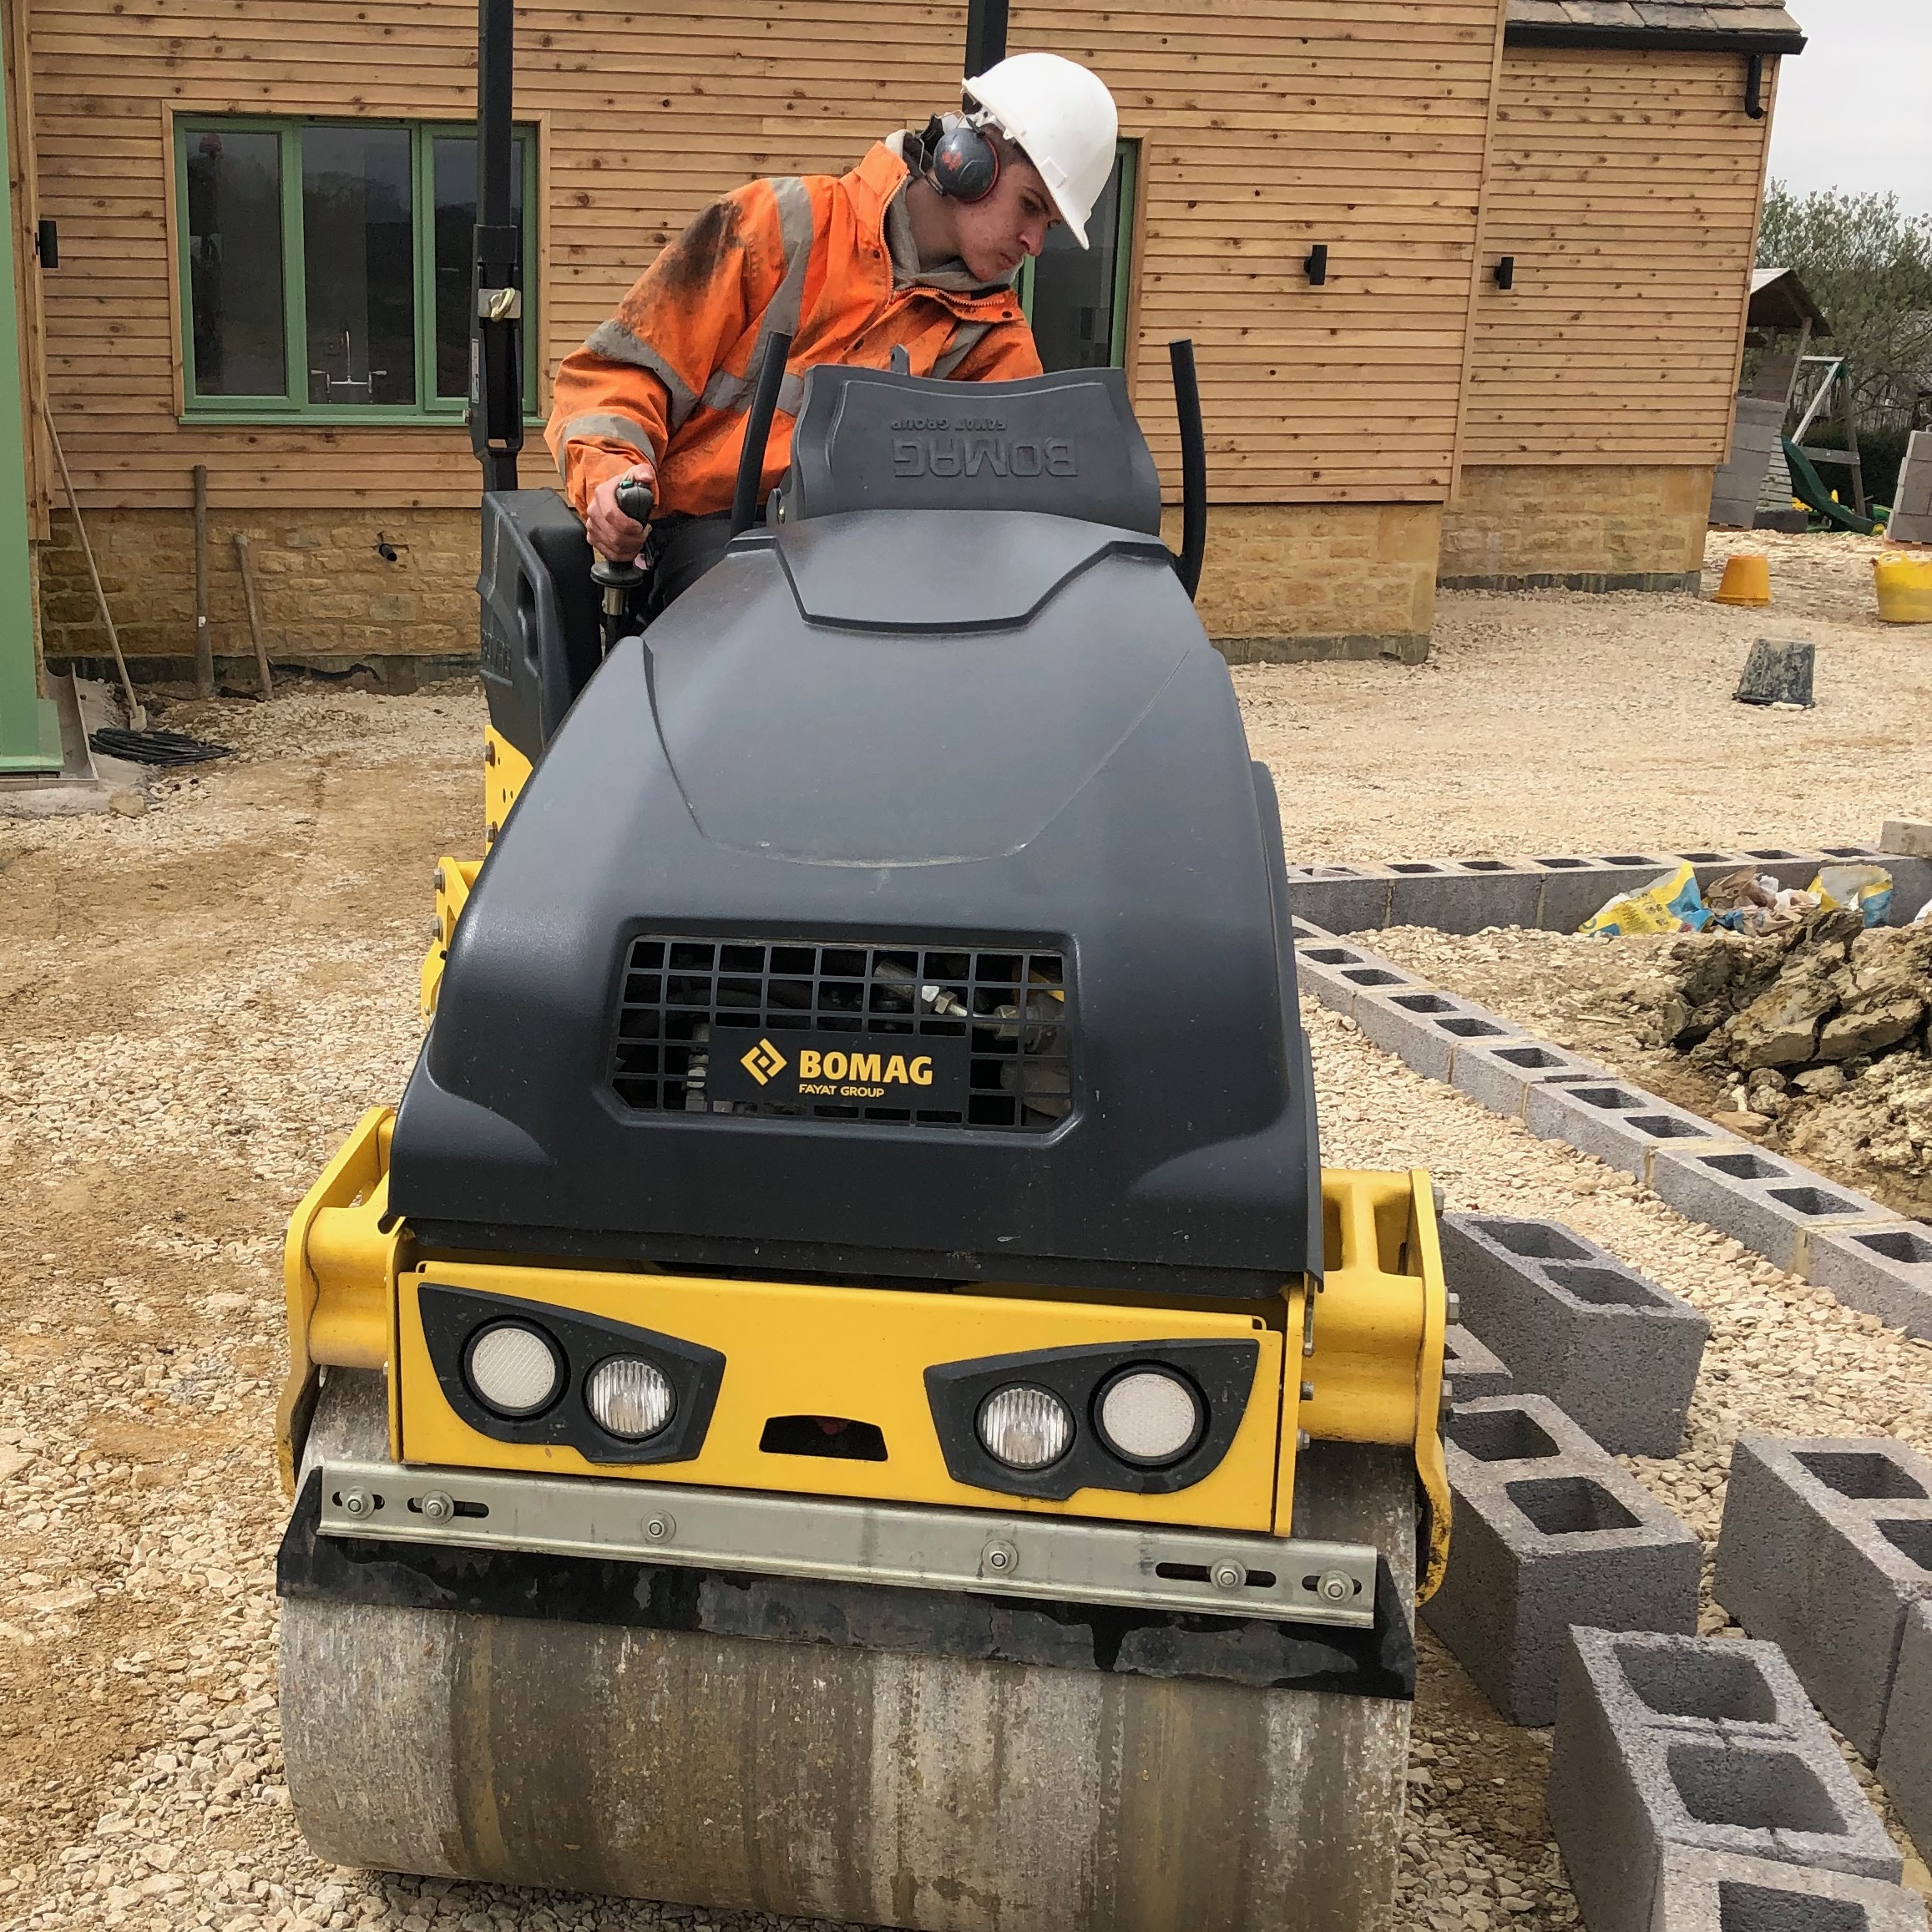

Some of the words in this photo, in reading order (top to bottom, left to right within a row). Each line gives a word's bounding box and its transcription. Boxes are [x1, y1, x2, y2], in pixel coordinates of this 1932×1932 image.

[891, 437, 1079, 478] BOMAG
[799, 1049, 933, 1085] BOMAG
[798, 1083, 837, 1095] FAYAT
[840, 1085, 885, 1098] GROUP
